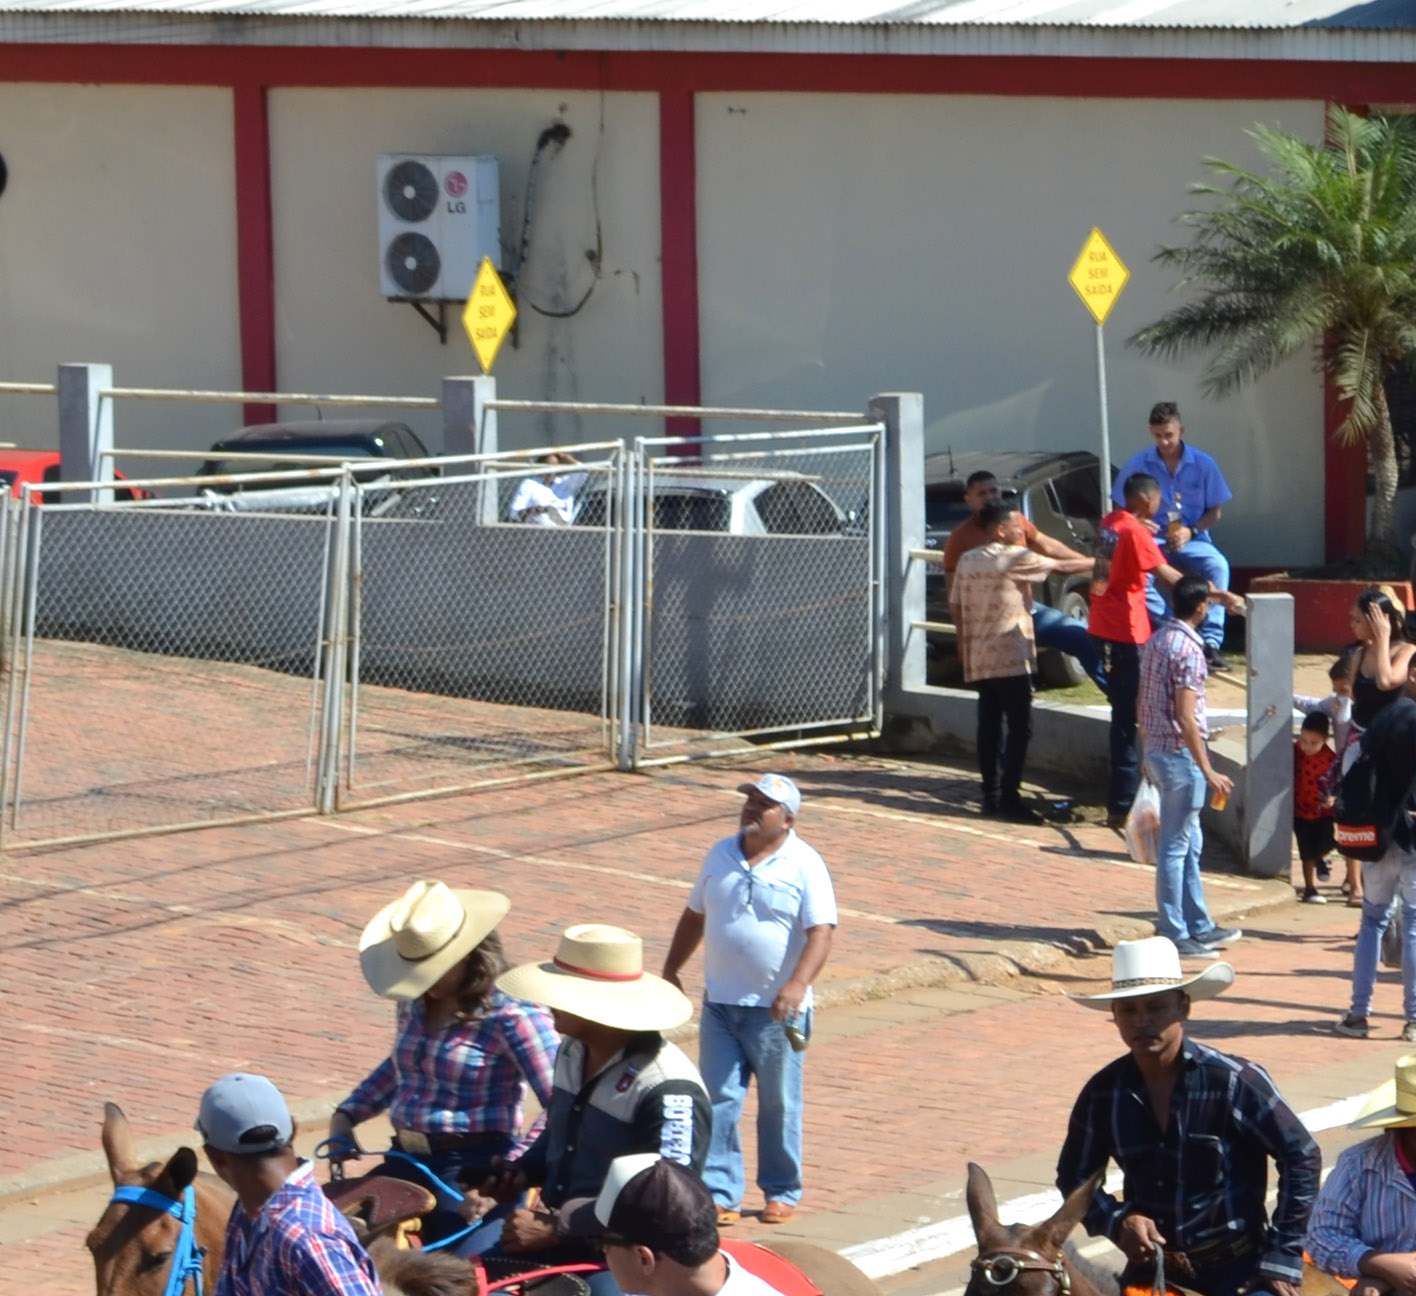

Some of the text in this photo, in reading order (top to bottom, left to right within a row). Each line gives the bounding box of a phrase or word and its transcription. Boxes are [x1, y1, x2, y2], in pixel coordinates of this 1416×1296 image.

[447, 202, 466, 214] LG
[1089, 251, 1107, 261] RUA
[1088, 268, 1108, 279] SEM
[480, 285, 495, 297] RUA
